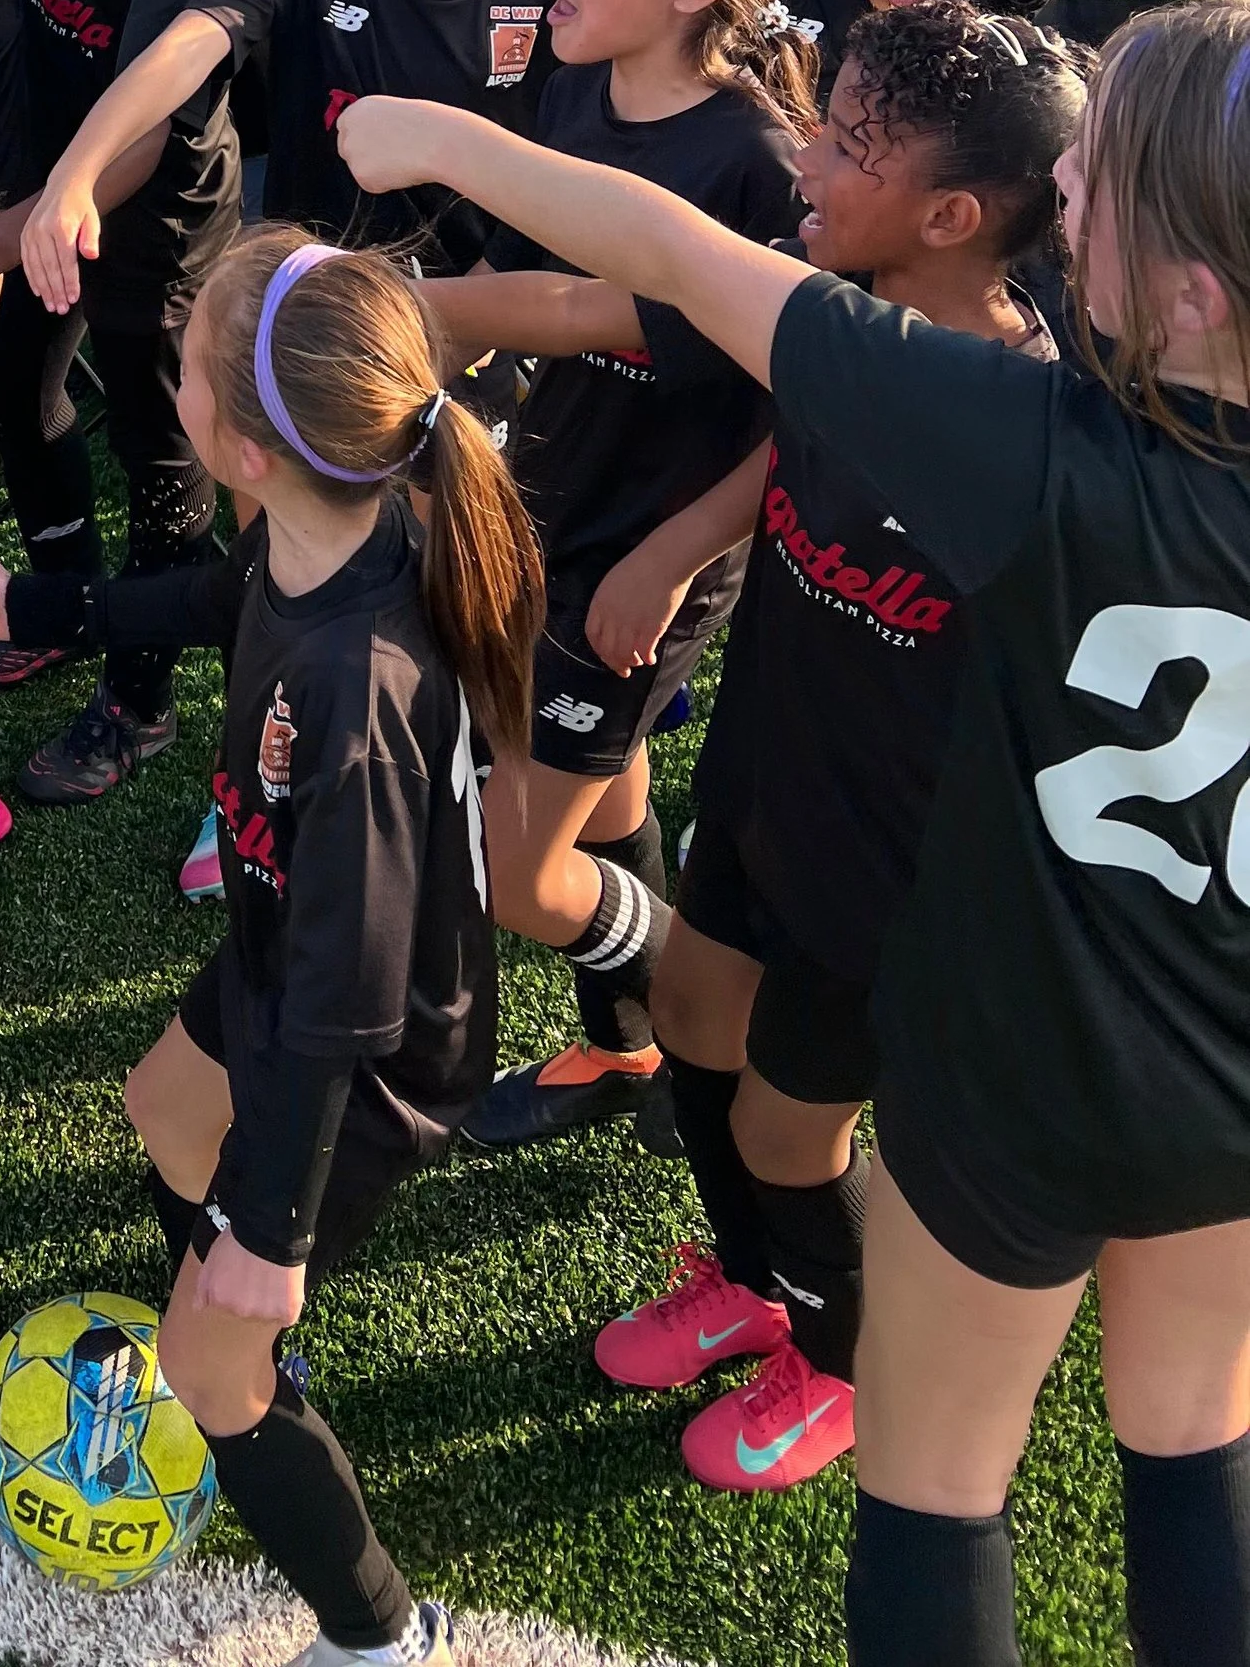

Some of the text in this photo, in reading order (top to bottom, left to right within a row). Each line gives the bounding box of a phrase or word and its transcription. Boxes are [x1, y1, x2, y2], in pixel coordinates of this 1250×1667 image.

[490, 5, 544, 20] DC WAY
[775, 538, 916, 648] NEAPOLITAN PIZZA
[1034, 603, 1250, 909] 2
[243, 862, 281, 890] PIZZ
[13, 1487, 160, 1557] SELECT
